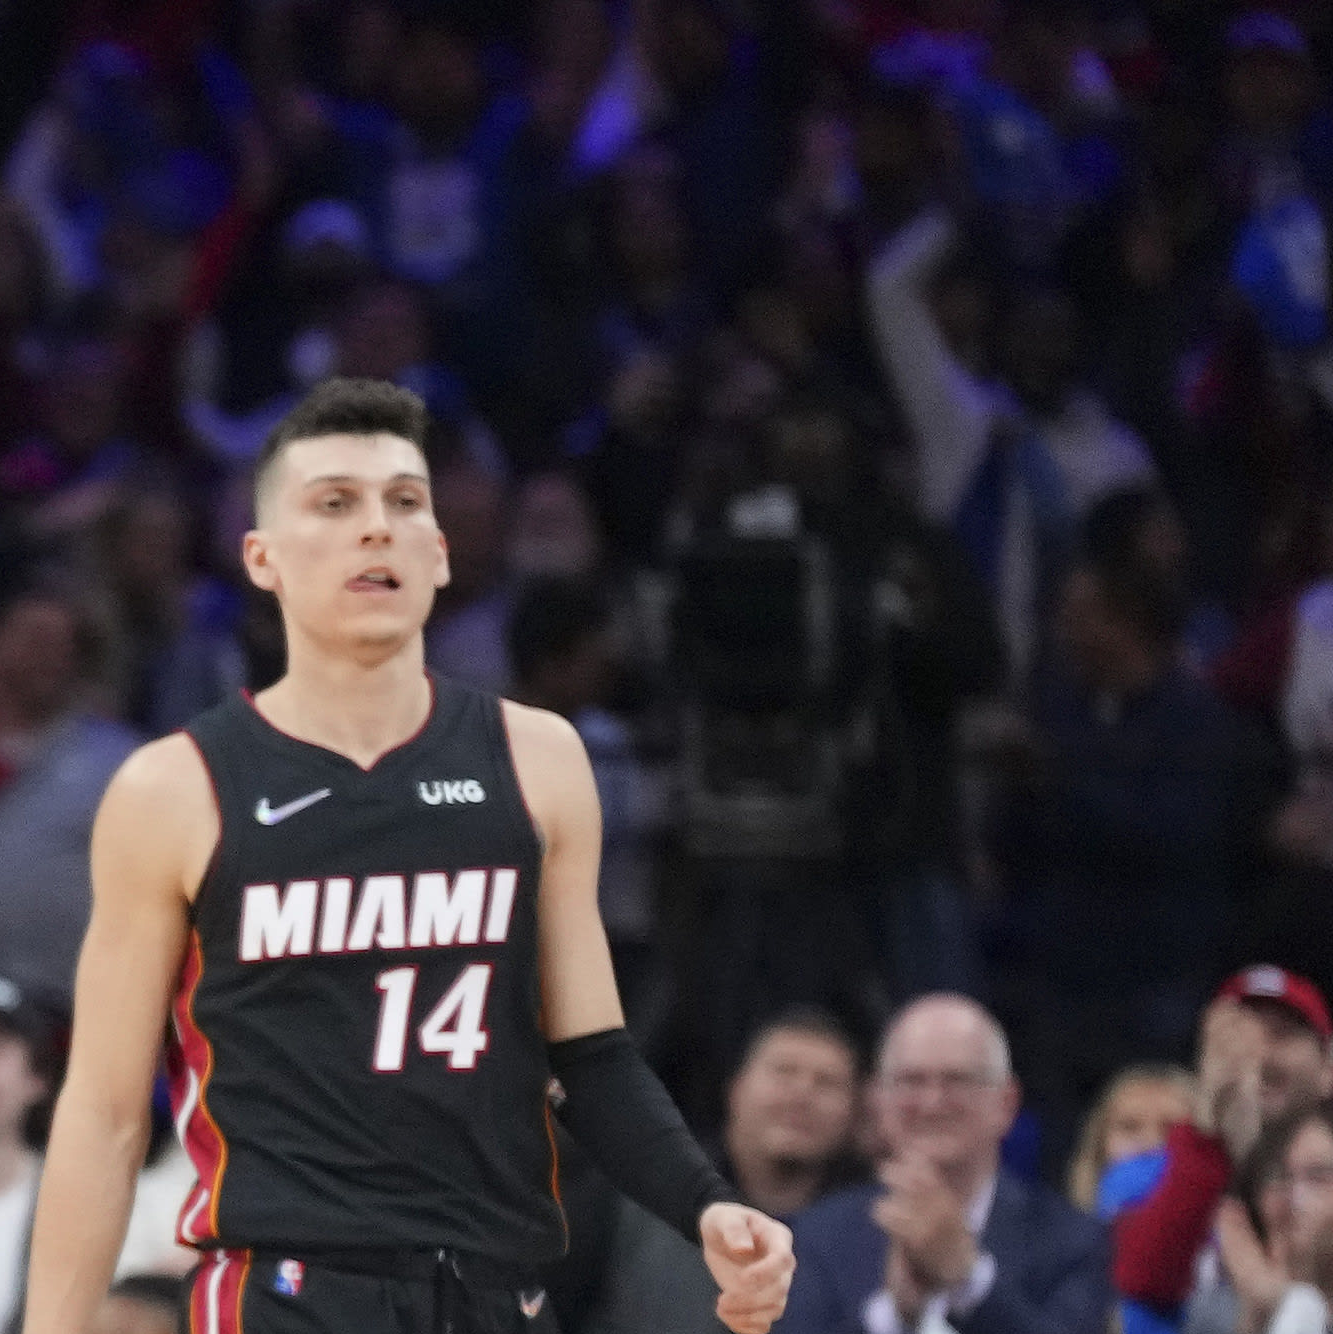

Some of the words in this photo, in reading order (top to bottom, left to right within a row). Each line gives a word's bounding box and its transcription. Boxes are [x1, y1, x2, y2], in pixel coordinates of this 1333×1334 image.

[416, 779, 487, 805] UKG
[238, 867, 520, 964] MIAMI
[372, 961, 494, 1073] 14
